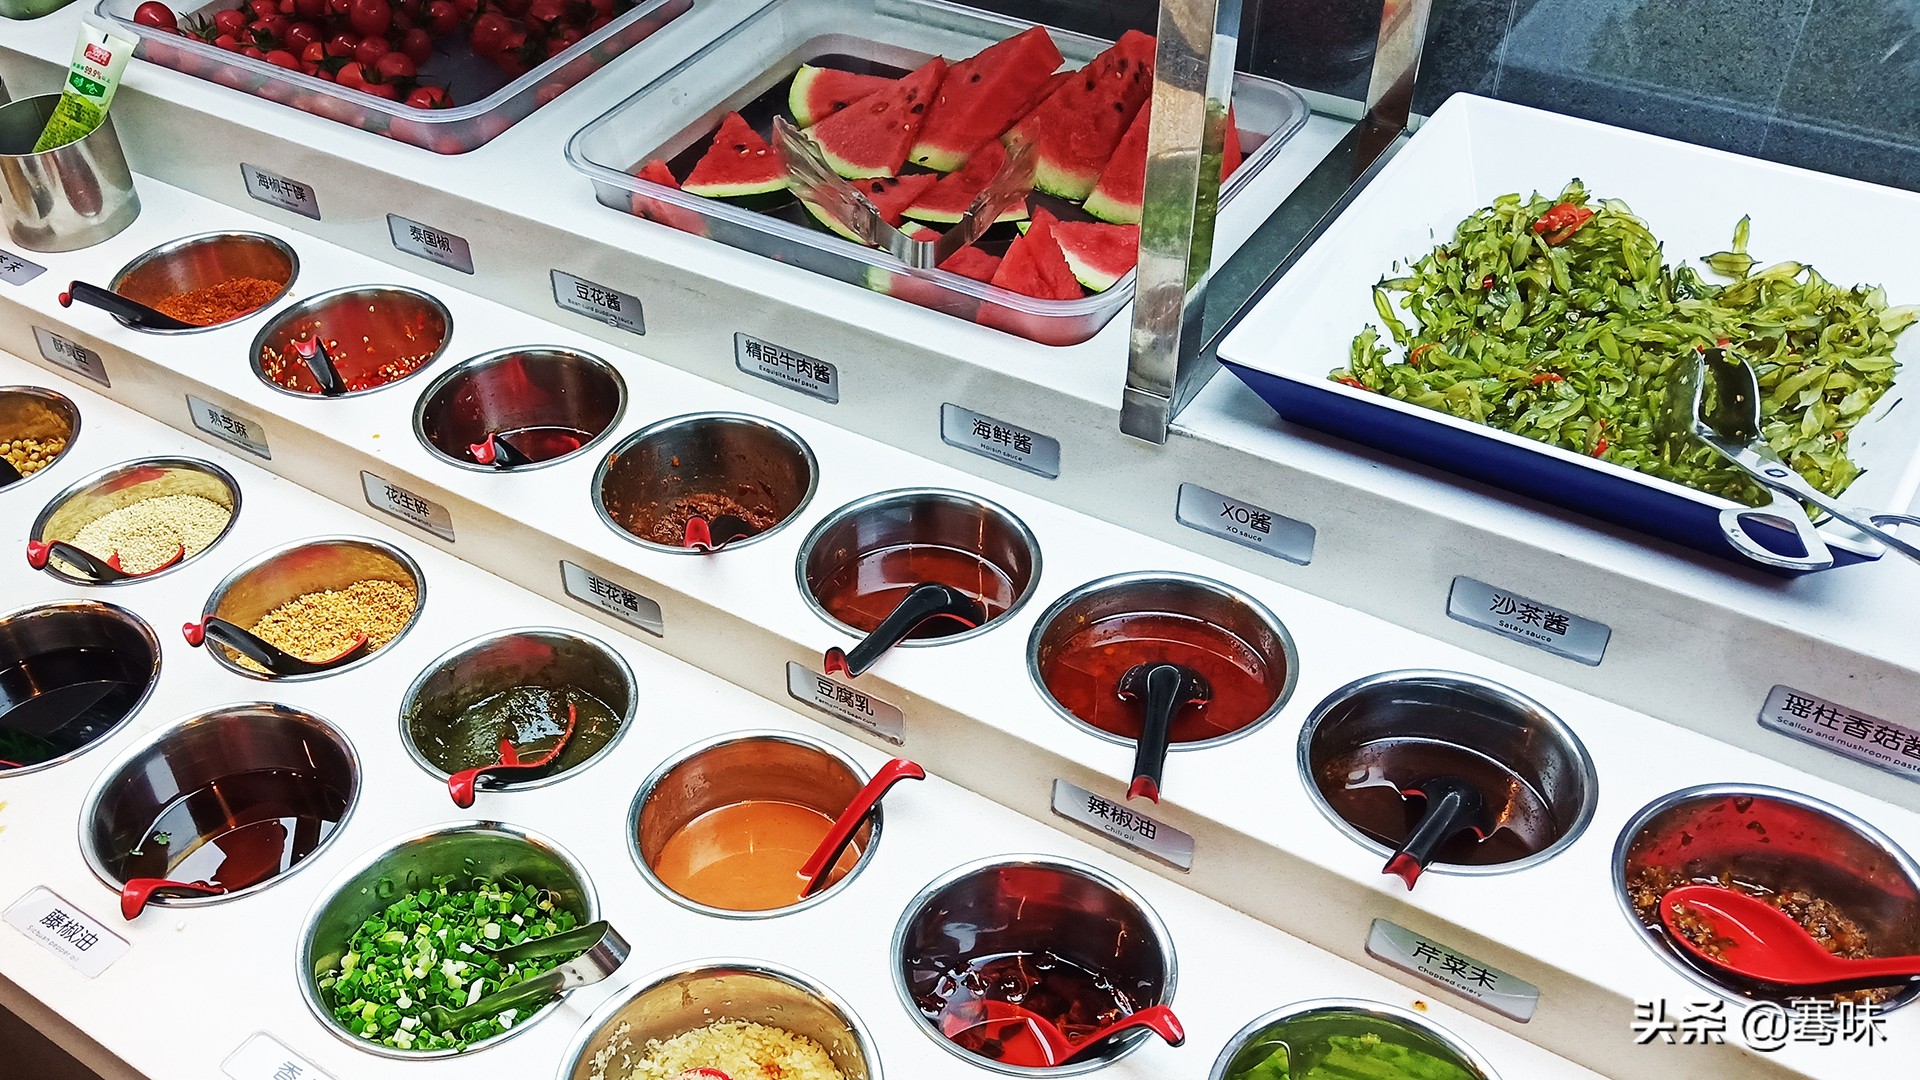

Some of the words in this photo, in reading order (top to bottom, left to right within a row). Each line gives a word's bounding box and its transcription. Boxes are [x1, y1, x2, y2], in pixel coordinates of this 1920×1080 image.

[256, 171, 308, 203] 海椒干碟
[409, 225, 453, 254] 泰国椒
[574, 281, 622, 312] 豆花酱
[745, 339, 832, 385] 精品牛肉酱
[801, 380, 819, 391] paste
[972, 418, 1033, 454] 海鲜酱
[980, 442, 1002, 454] Hoisin
[1003, 450, 1023, 462] sauce
[383, 485, 430, 518] 花生碎
[1219, 502, 1273, 534] XO酱
[1225, 524, 1238, 534] XO
[1239, 530, 1263, 543] sauce
[588, 576, 639, 613] 韭花酱
[1489, 593, 1570, 636] 沙茶酱
[1498, 619, 1524, 634] Satay
[1525, 629, 1552, 643] sauce
[816, 676, 875, 717] 豆腐乳
[1776, 716, 1814, 735] Scallop
[1815, 730, 1835, 743] and
[1836, 738, 1896, 762] mushroom
[1087, 795, 1157, 840] 辣椒油
[1104, 824, 1122, 836] Chili
[1123, 833, 1135, 842] oil
[39, 908, 99, 952] 藤椒油
[1412, 940, 1498, 991] 芹菜末
[1417, 964, 1456, 985] Chopped
[1456, 982, 1483, 998] celery
